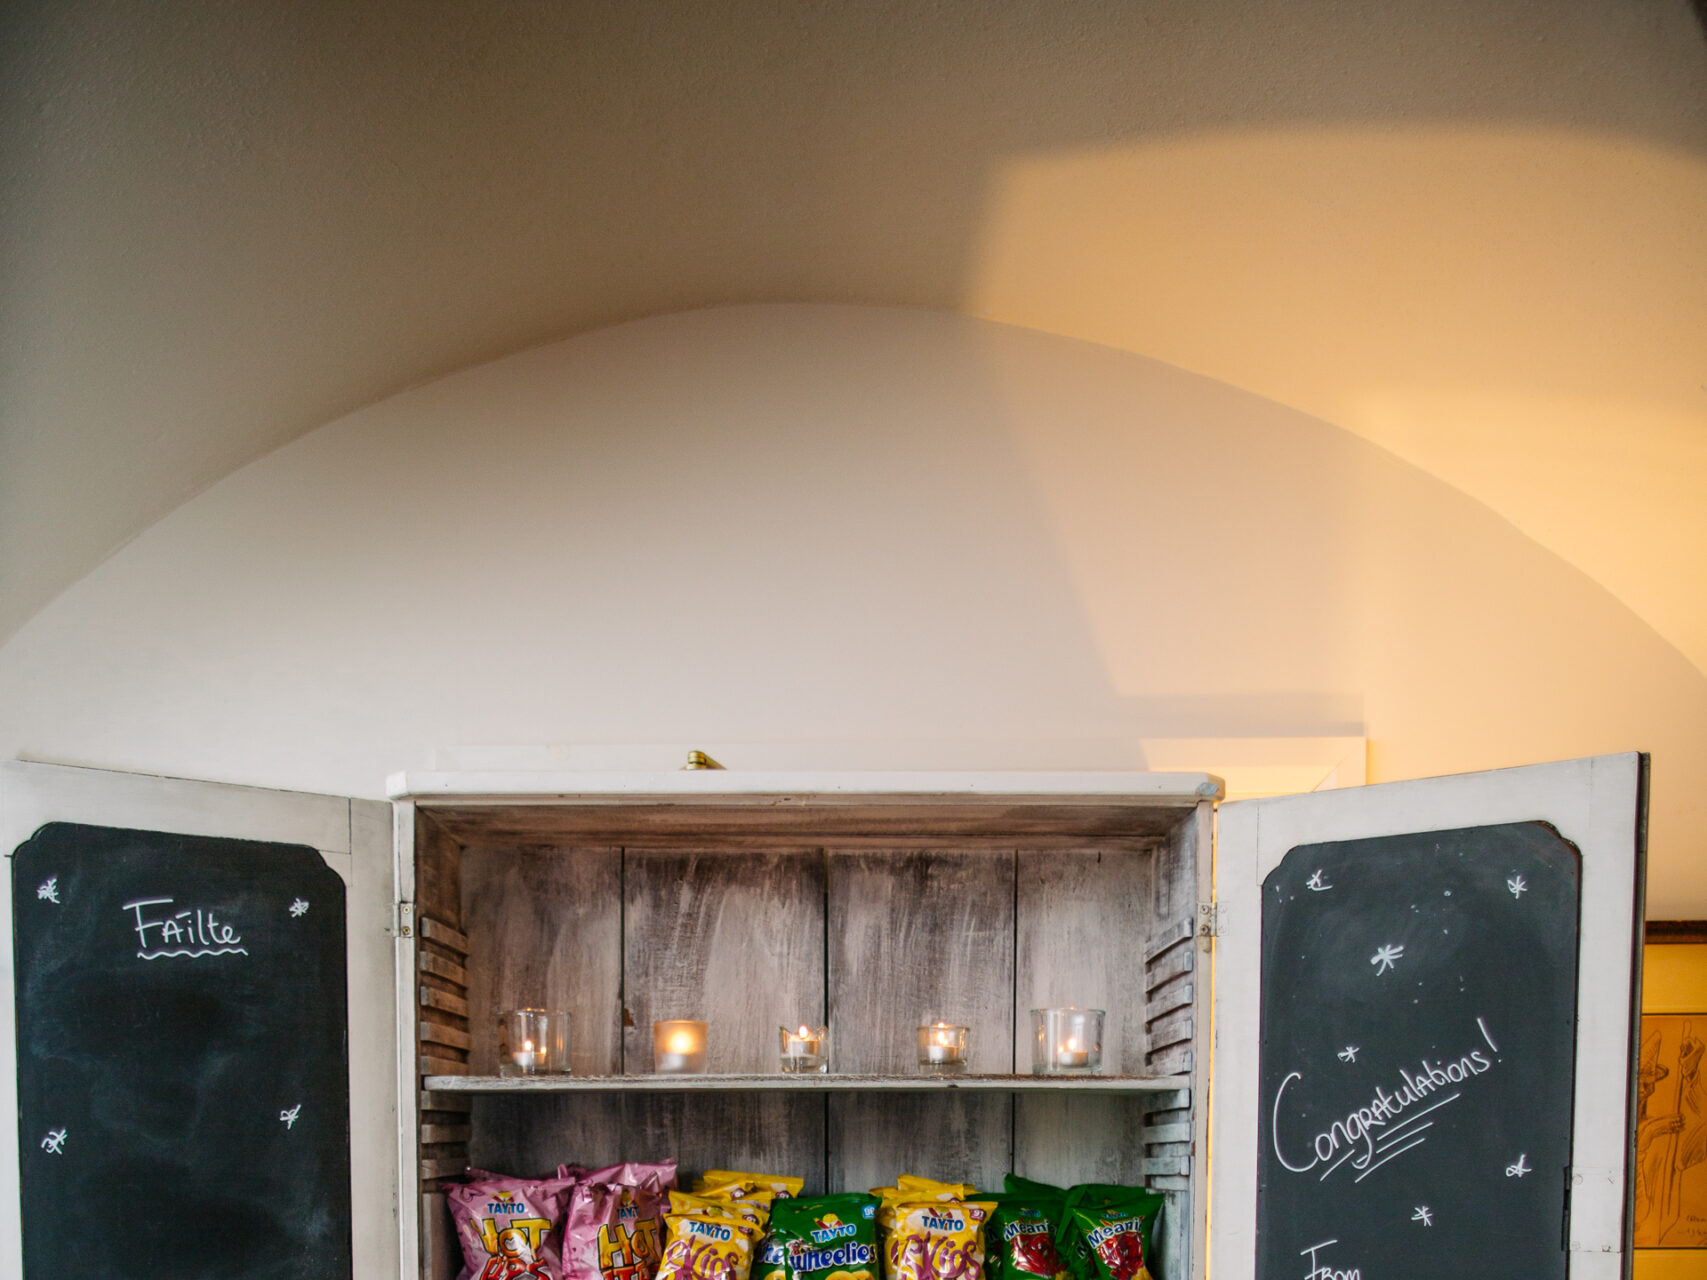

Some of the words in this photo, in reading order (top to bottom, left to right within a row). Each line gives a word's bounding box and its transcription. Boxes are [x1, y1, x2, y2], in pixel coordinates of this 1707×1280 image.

[487, 1202, 526, 1215] TAYTO
[688, 1221, 732, 1242] TAYTO
[921, 1214, 965, 1232] TAYTO
[811, 1223, 857, 1244] TAYTO
